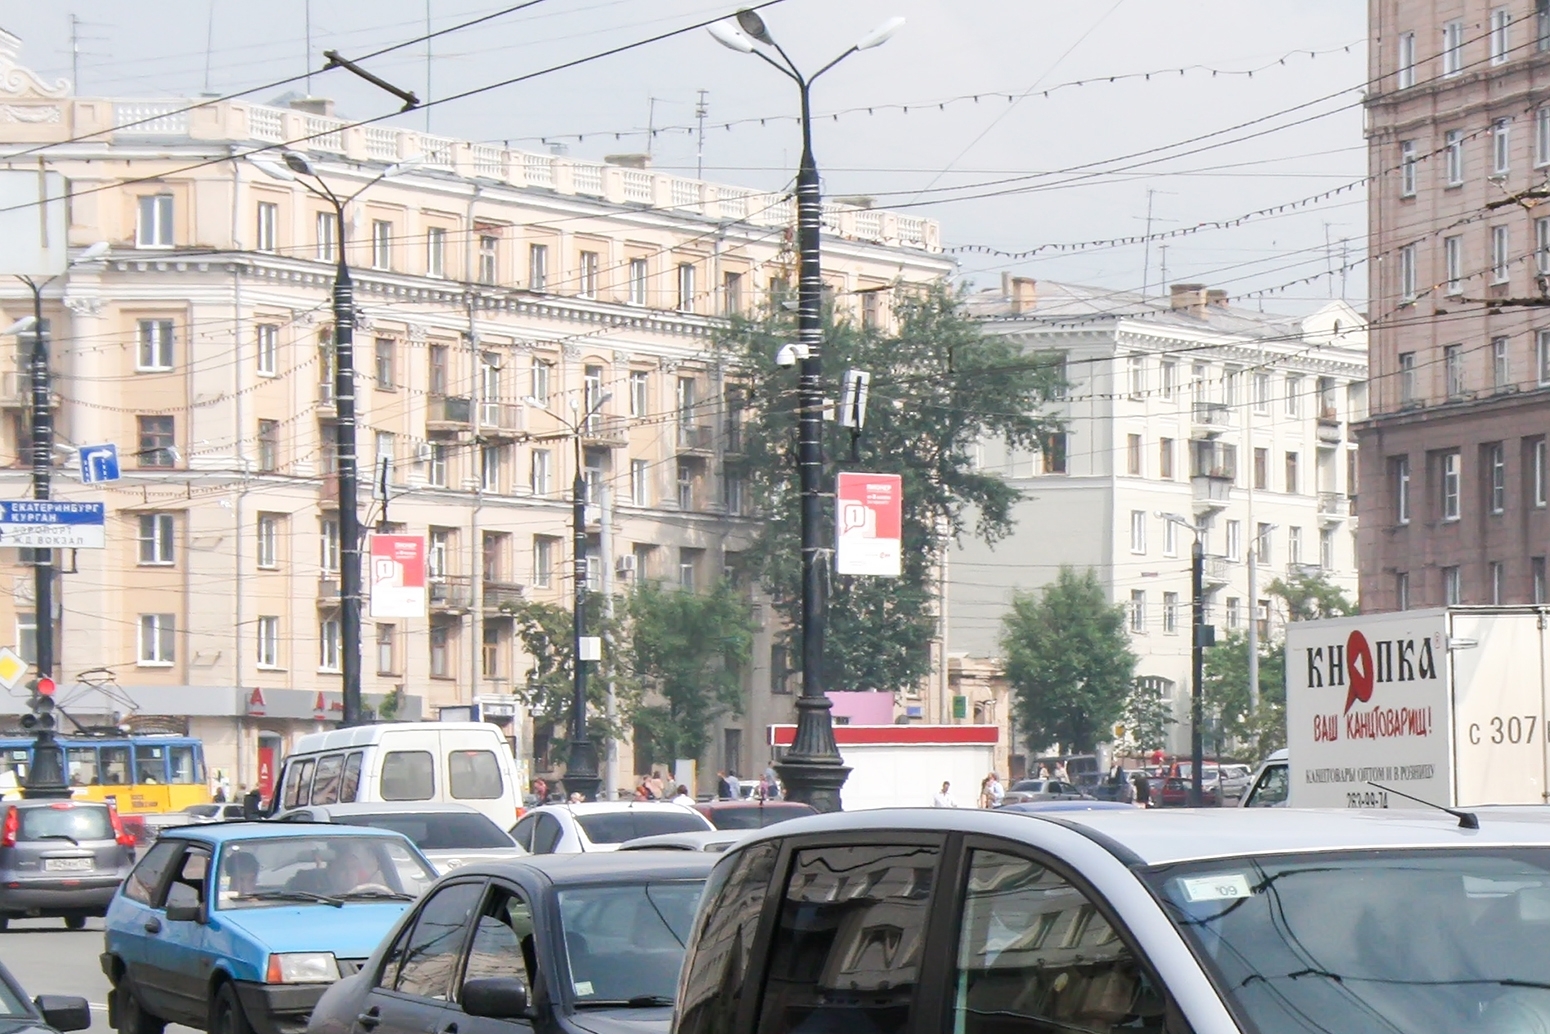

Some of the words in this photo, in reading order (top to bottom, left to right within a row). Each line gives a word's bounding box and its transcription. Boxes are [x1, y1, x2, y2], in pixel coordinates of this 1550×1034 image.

[11, 503, 99, 513] ЕКАТЕРИНБУРГ
[11, 513, 57, 522] КУРГАН
[37, 537, 84, 545] ВОКЗАЛ
[1313, 714, 1338, 742] ВАШ
[1346, 705, 1432, 741] КАНЦТОВАРИЩ!
[1490, 716, 1537, 744] 307
[1357, 766, 1385, 782] ОПТОМ
[1394, 766, 1400, 781] В
